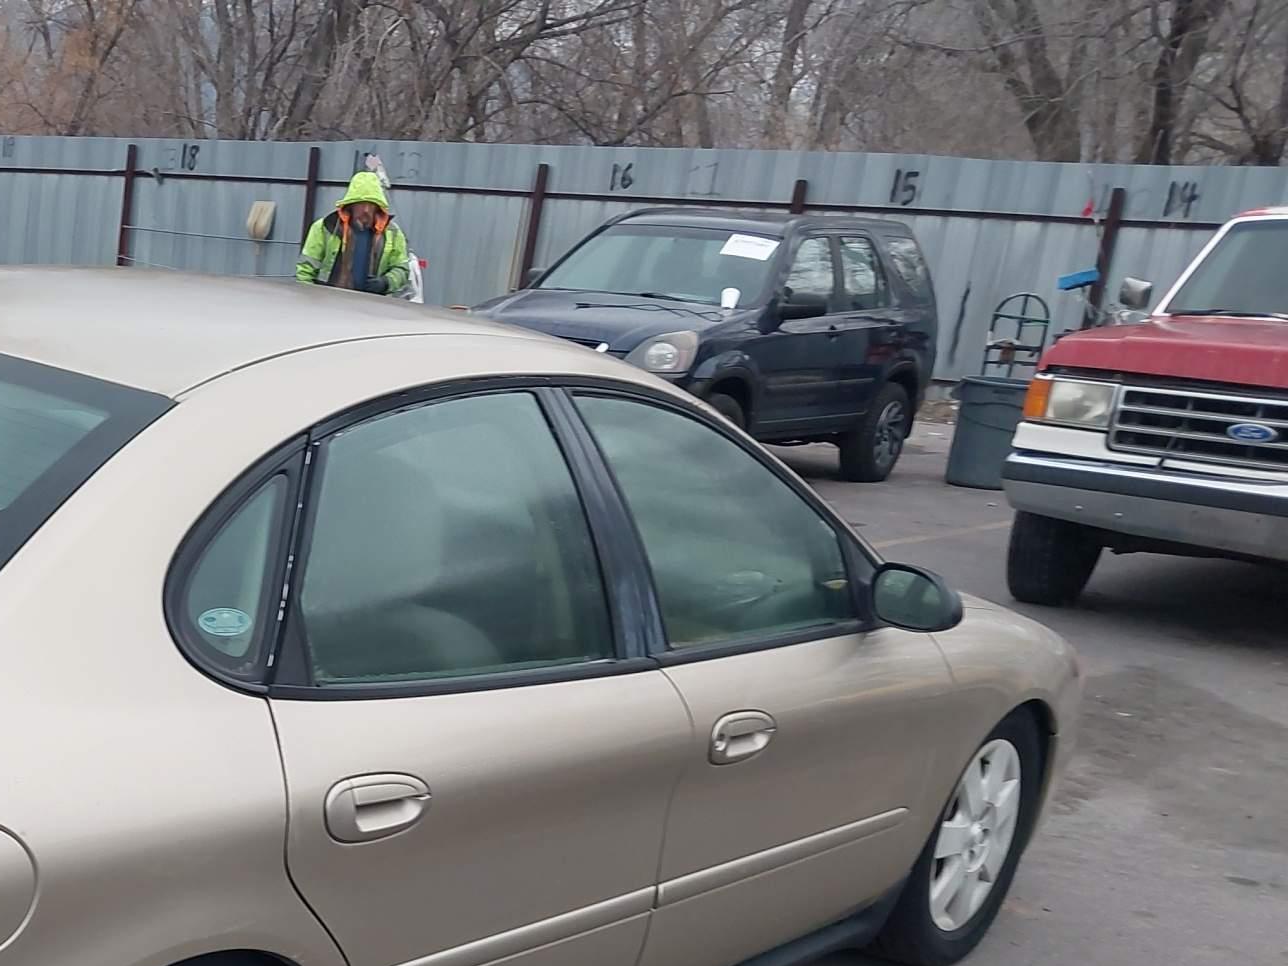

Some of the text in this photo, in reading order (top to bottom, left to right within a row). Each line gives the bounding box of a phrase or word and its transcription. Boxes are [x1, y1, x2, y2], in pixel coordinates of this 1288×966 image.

[181, 143, 200, 171] 18
[610, 162, 634, 191] 16
[889, 169, 920, 206] 15
[1162, 181, 1200, 218] 14
